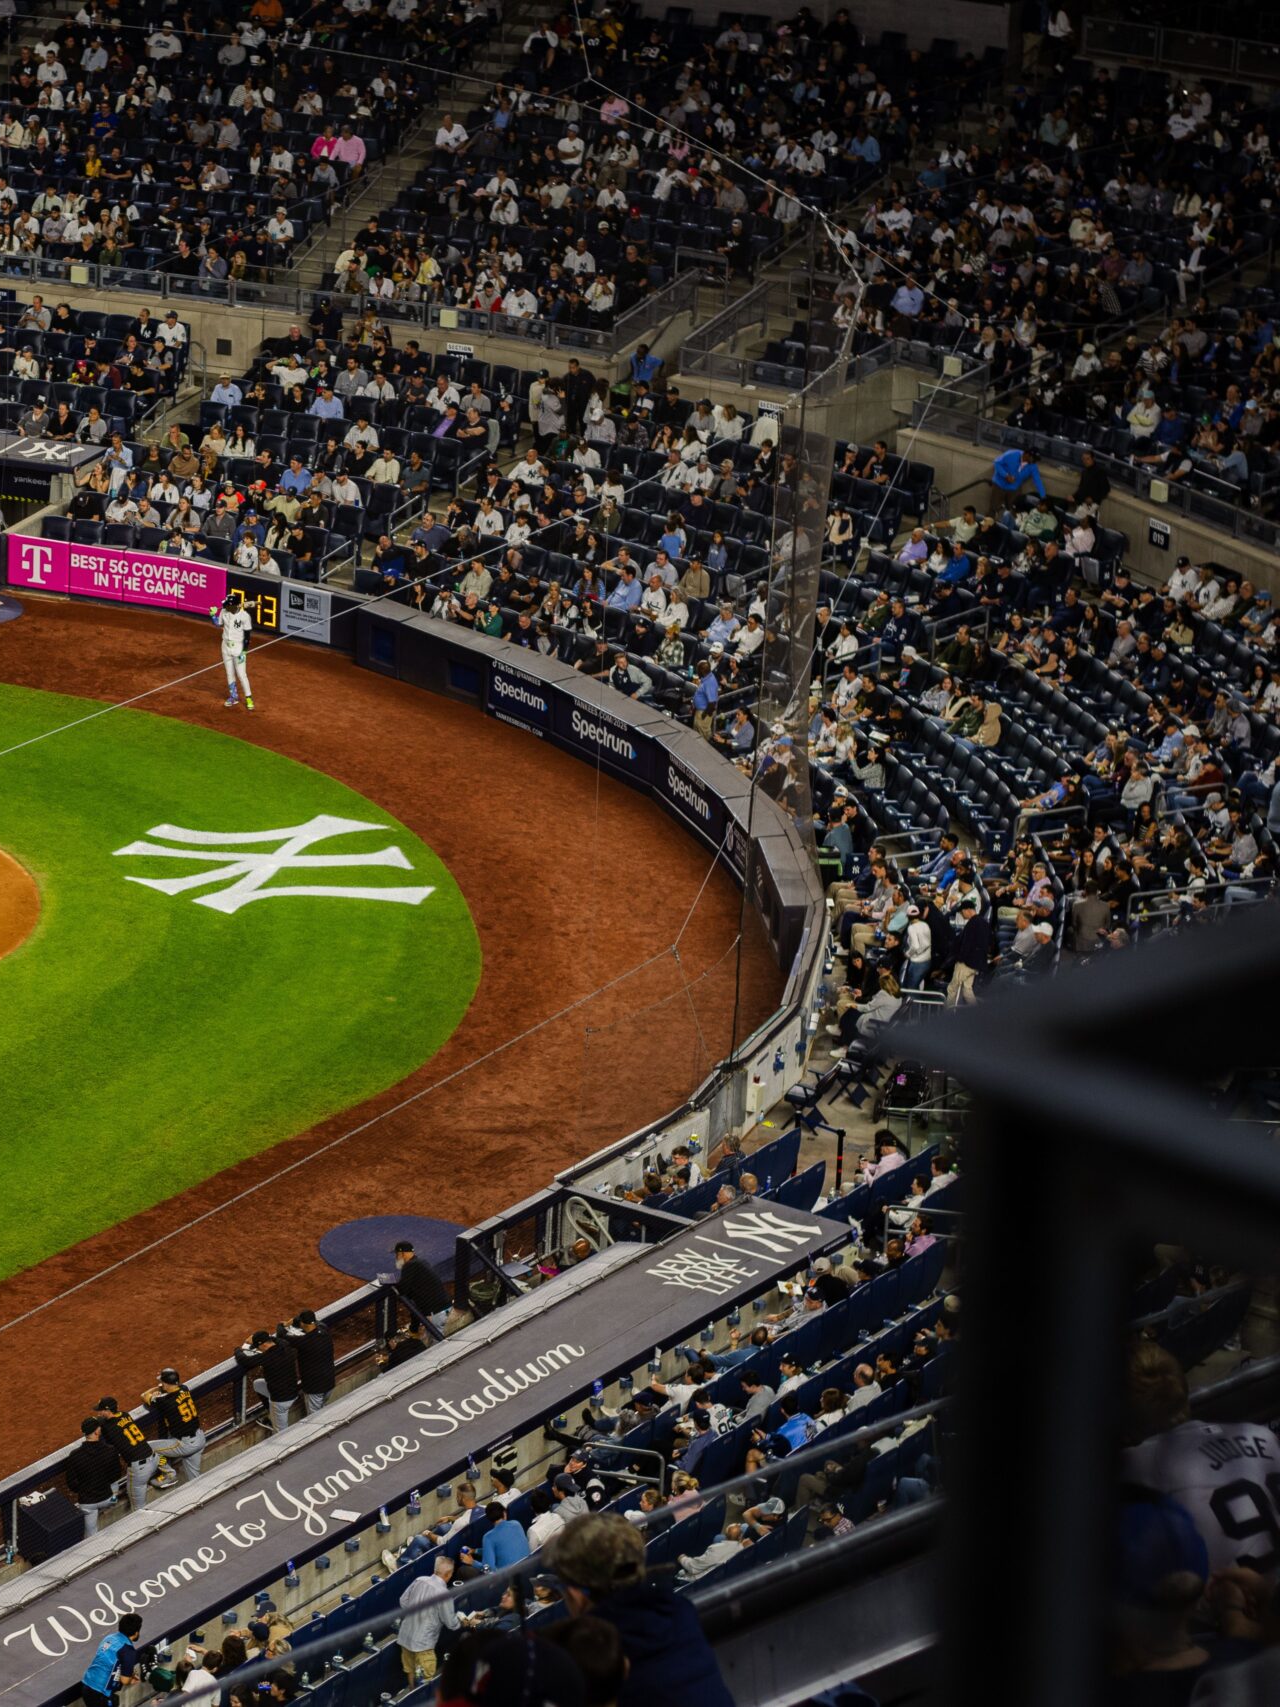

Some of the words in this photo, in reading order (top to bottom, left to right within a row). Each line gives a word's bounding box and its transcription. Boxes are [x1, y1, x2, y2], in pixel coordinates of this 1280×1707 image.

[448, 344, 472, 352] SECTION
[1152, 532, 1164, 546] 019
[70, 553, 106, 572] BEST
[109, 559, 129, 574] 5G
[132, 562, 207, 588] COVERAGE
[94, 572, 109, 588] IN
[114, 575, 140, 592] THE
[144, 579, 185, 599] GAME
[494, 676, 545, 712] Spectrum
[572, 710, 633, 760] Spectrum
[668, 766, 709, 820] Spectrum
[645, 1248, 709, 1281] NEW
[663, 1252, 740, 1289] YORK
[692, 1264, 759, 1295] LIFE
[408, 1343, 585, 1437] Stadium
[124, 1424, 144, 1446] 19
[1200, 1436, 1274, 1470] JUDGE
[236, 1435, 419, 1536] Yankee
[211, 1518, 266, 1548] to
[4, 1546, 226, 1657] Welcome
